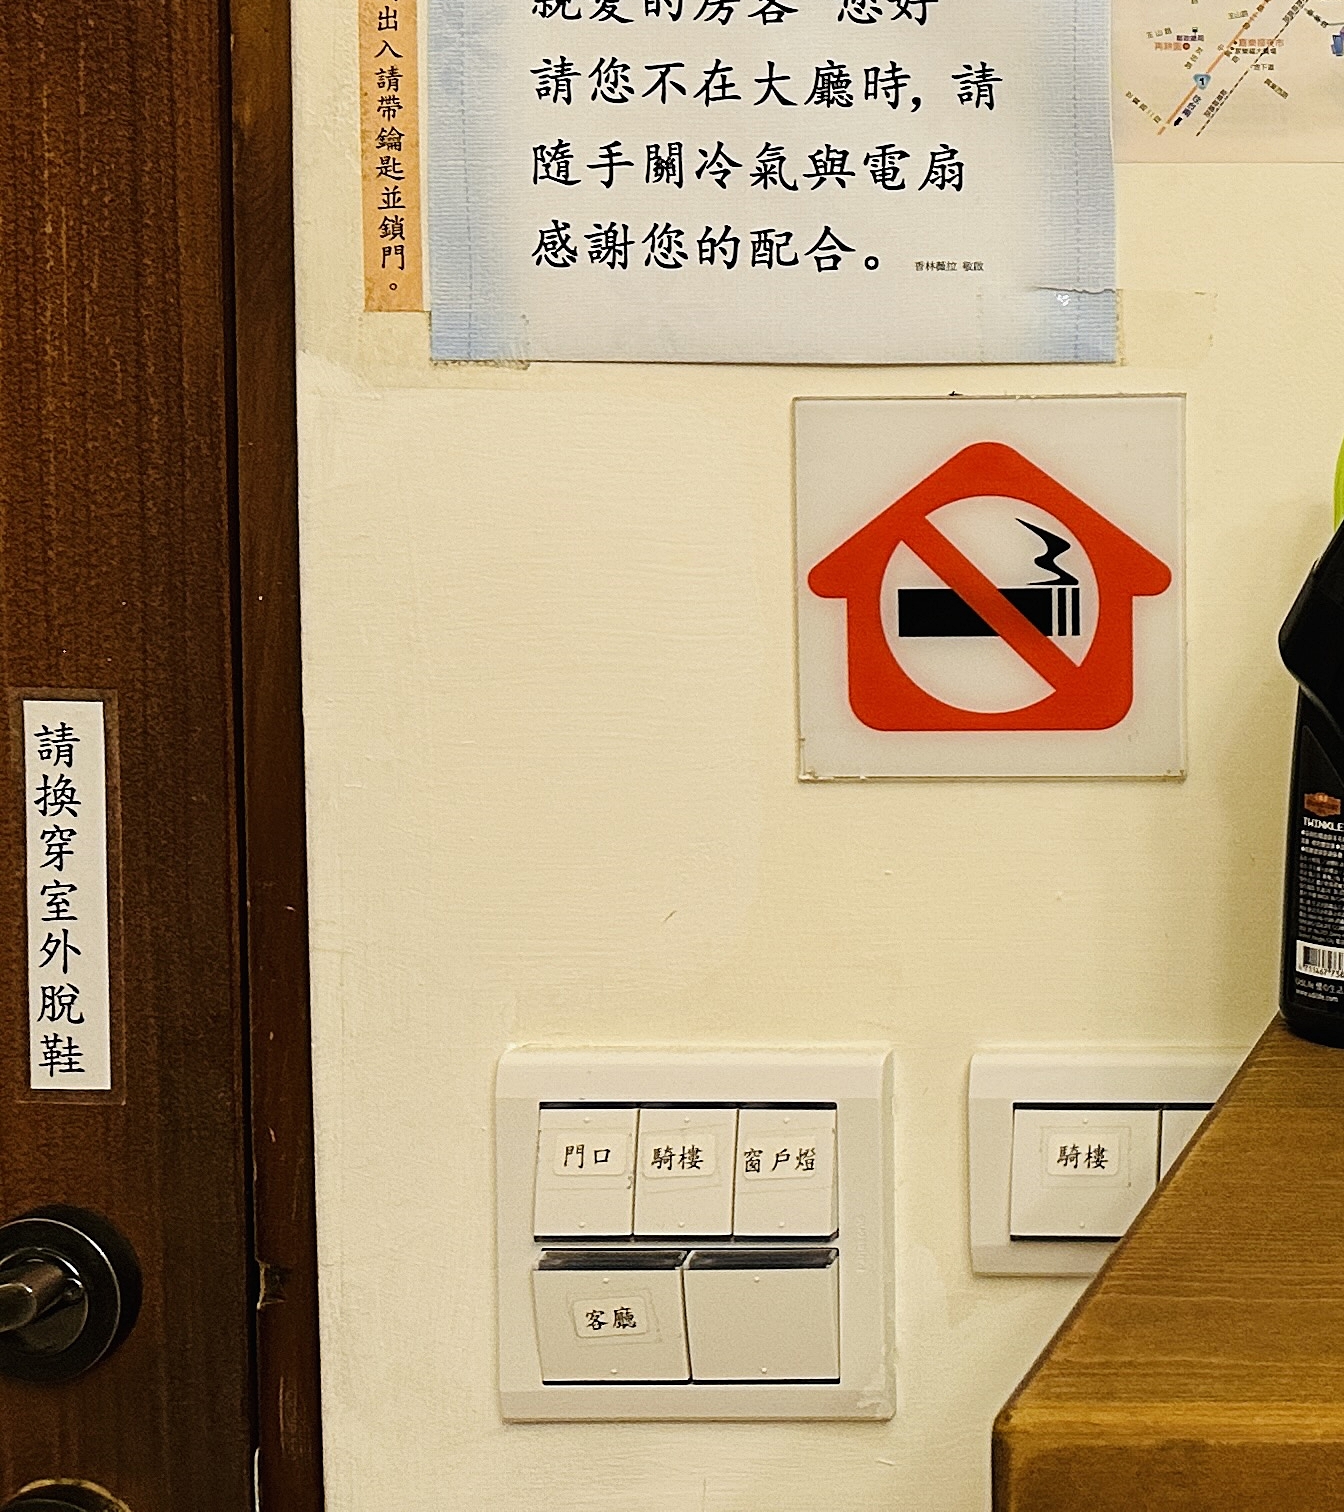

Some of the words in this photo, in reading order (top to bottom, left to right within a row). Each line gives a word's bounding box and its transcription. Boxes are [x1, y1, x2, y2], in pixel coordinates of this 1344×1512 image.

[531, 140, 966, 192] 隨手關冷氣與電扇
[531, 220, 880, 274] 感謝您的配合。
[1304, 817, 1344, 832] TWINKLE
[34, 721, 85, 1078] 請換穿室外脫鞋
[563, 1144, 612, 1170] 門口
[652, 1145, 704, 1171] 騎樓
[743, 1147, 817, 1175] 窗戶燈
[1056, 1144, 1109, 1171] 騎樓
[585, 1307, 637, 1332] 客廳
